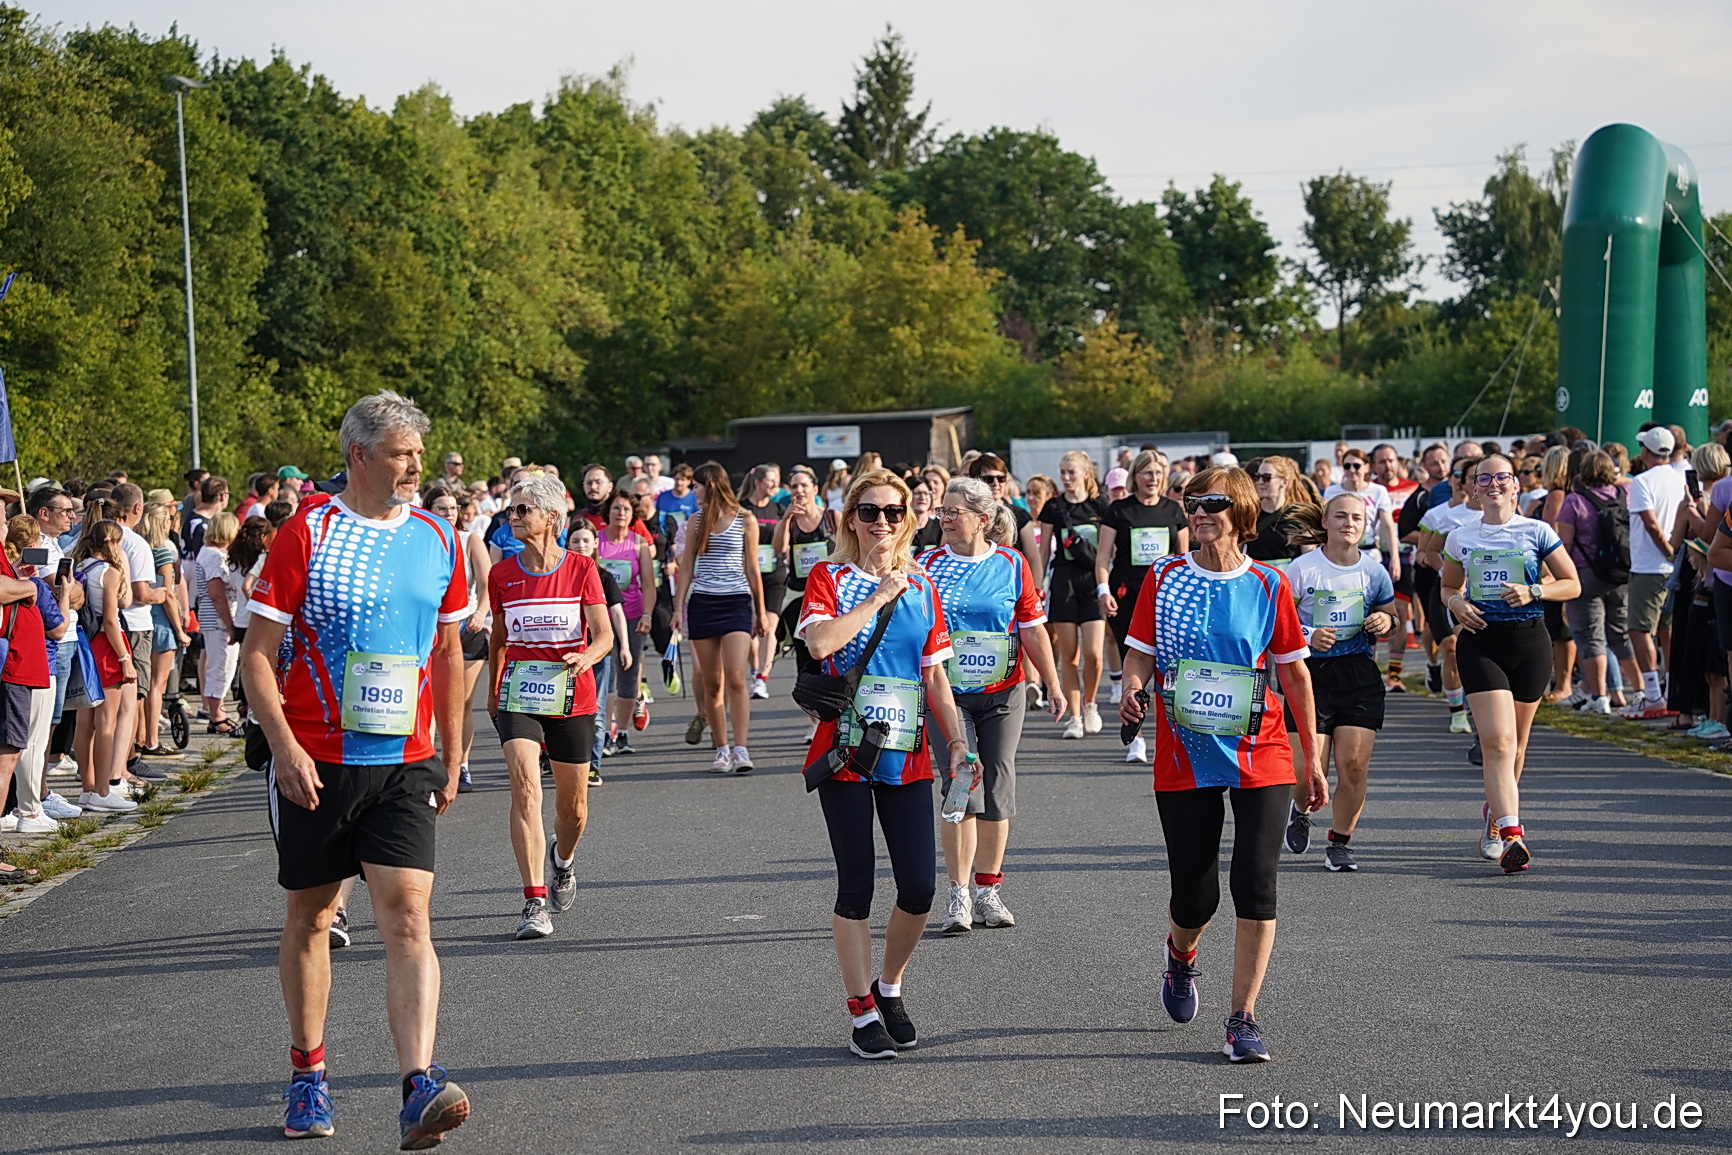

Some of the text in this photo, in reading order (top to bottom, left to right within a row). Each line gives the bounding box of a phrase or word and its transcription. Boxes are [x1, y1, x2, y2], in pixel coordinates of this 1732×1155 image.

[1634, 389, 1653, 409] AO
[1688, 388, 1708, 407] AO
[1141, 543, 1159, 551] 1251
[1483, 570, 1508, 582] 378
[523, 615, 568, 626] Petry
[1330, 611, 1347, 622] 311
[958, 653, 996, 667] 2003
[360, 685, 403, 704] 1998
[519, 681, 555, 695] 2005
[1190, 690, 1233, 709] 2001
[352, 704, 408, 716] Christian Baumer
[863, 705, 906, 723] 2006
[1180, 706, 1243, 721] Theresa Blendinger
[887, 726, 917, 735] omarovska
